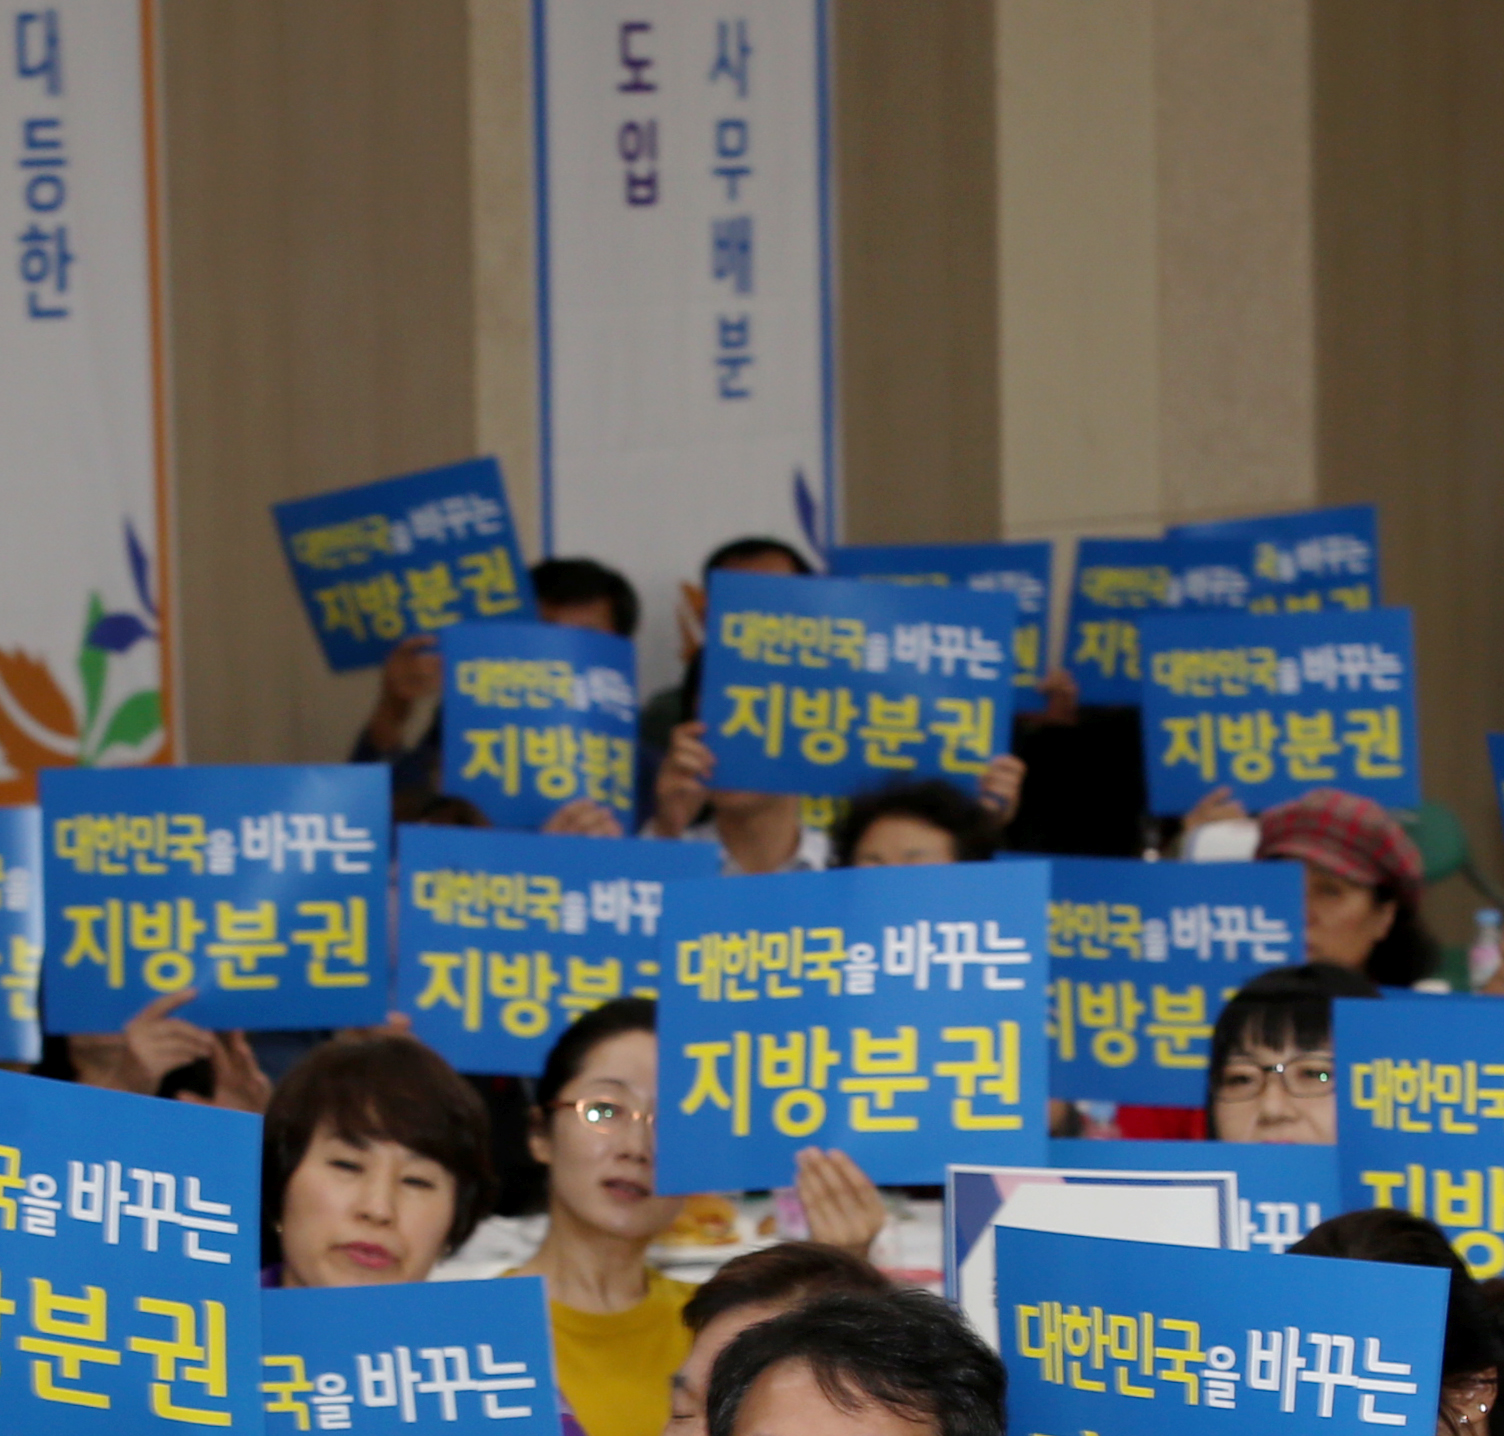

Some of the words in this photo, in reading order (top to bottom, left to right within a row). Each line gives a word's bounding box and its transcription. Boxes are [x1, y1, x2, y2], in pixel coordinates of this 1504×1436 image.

[615, 19, 658, 206] 도입
[13, 9, 76, 322] 대등한
[709, 17, 754, 400] 사무배분
[314, 547, 522, 643] 지방분권
[720, 610, 888, 673] 대한민국을
[894, 621, 1004, 680] 바꾸는
[1152, 647, 1300, 696] 대한민국을
[1301, 644, 1403, 691] 바꾸는
[721, 683, 994, 775] 지방분권
[1162, 705, 1404, 783] 지방분권
[55, 811, 237, 875] 대한민국을
[241, 812, 376, 875] 바꾸는
[62, 897, 369, 992] 지방분권
[412, 868, 586, 934] 대한민국을
[591, 879, 662, 936] 바꾸
[1048, 902, 1167, 960] 한민국을
[1170, 906, 1290, 961] 바꾸는
[418, 948, 660, 1038] 지방분
[676, 927, 880, 1003] 대한민국을
[883, 919, 1034, 993] 바꾸는
[680, 1020, 1024, 1138] 지방분권
[68, 1160, 237, 1263] 바꾸는
[365, 1342, 537, 1422] 바꾸는
[1014, 1302, 1241, 1410] 대한민국을
[1245, 1326, 1418, 1428] 바꾸는
